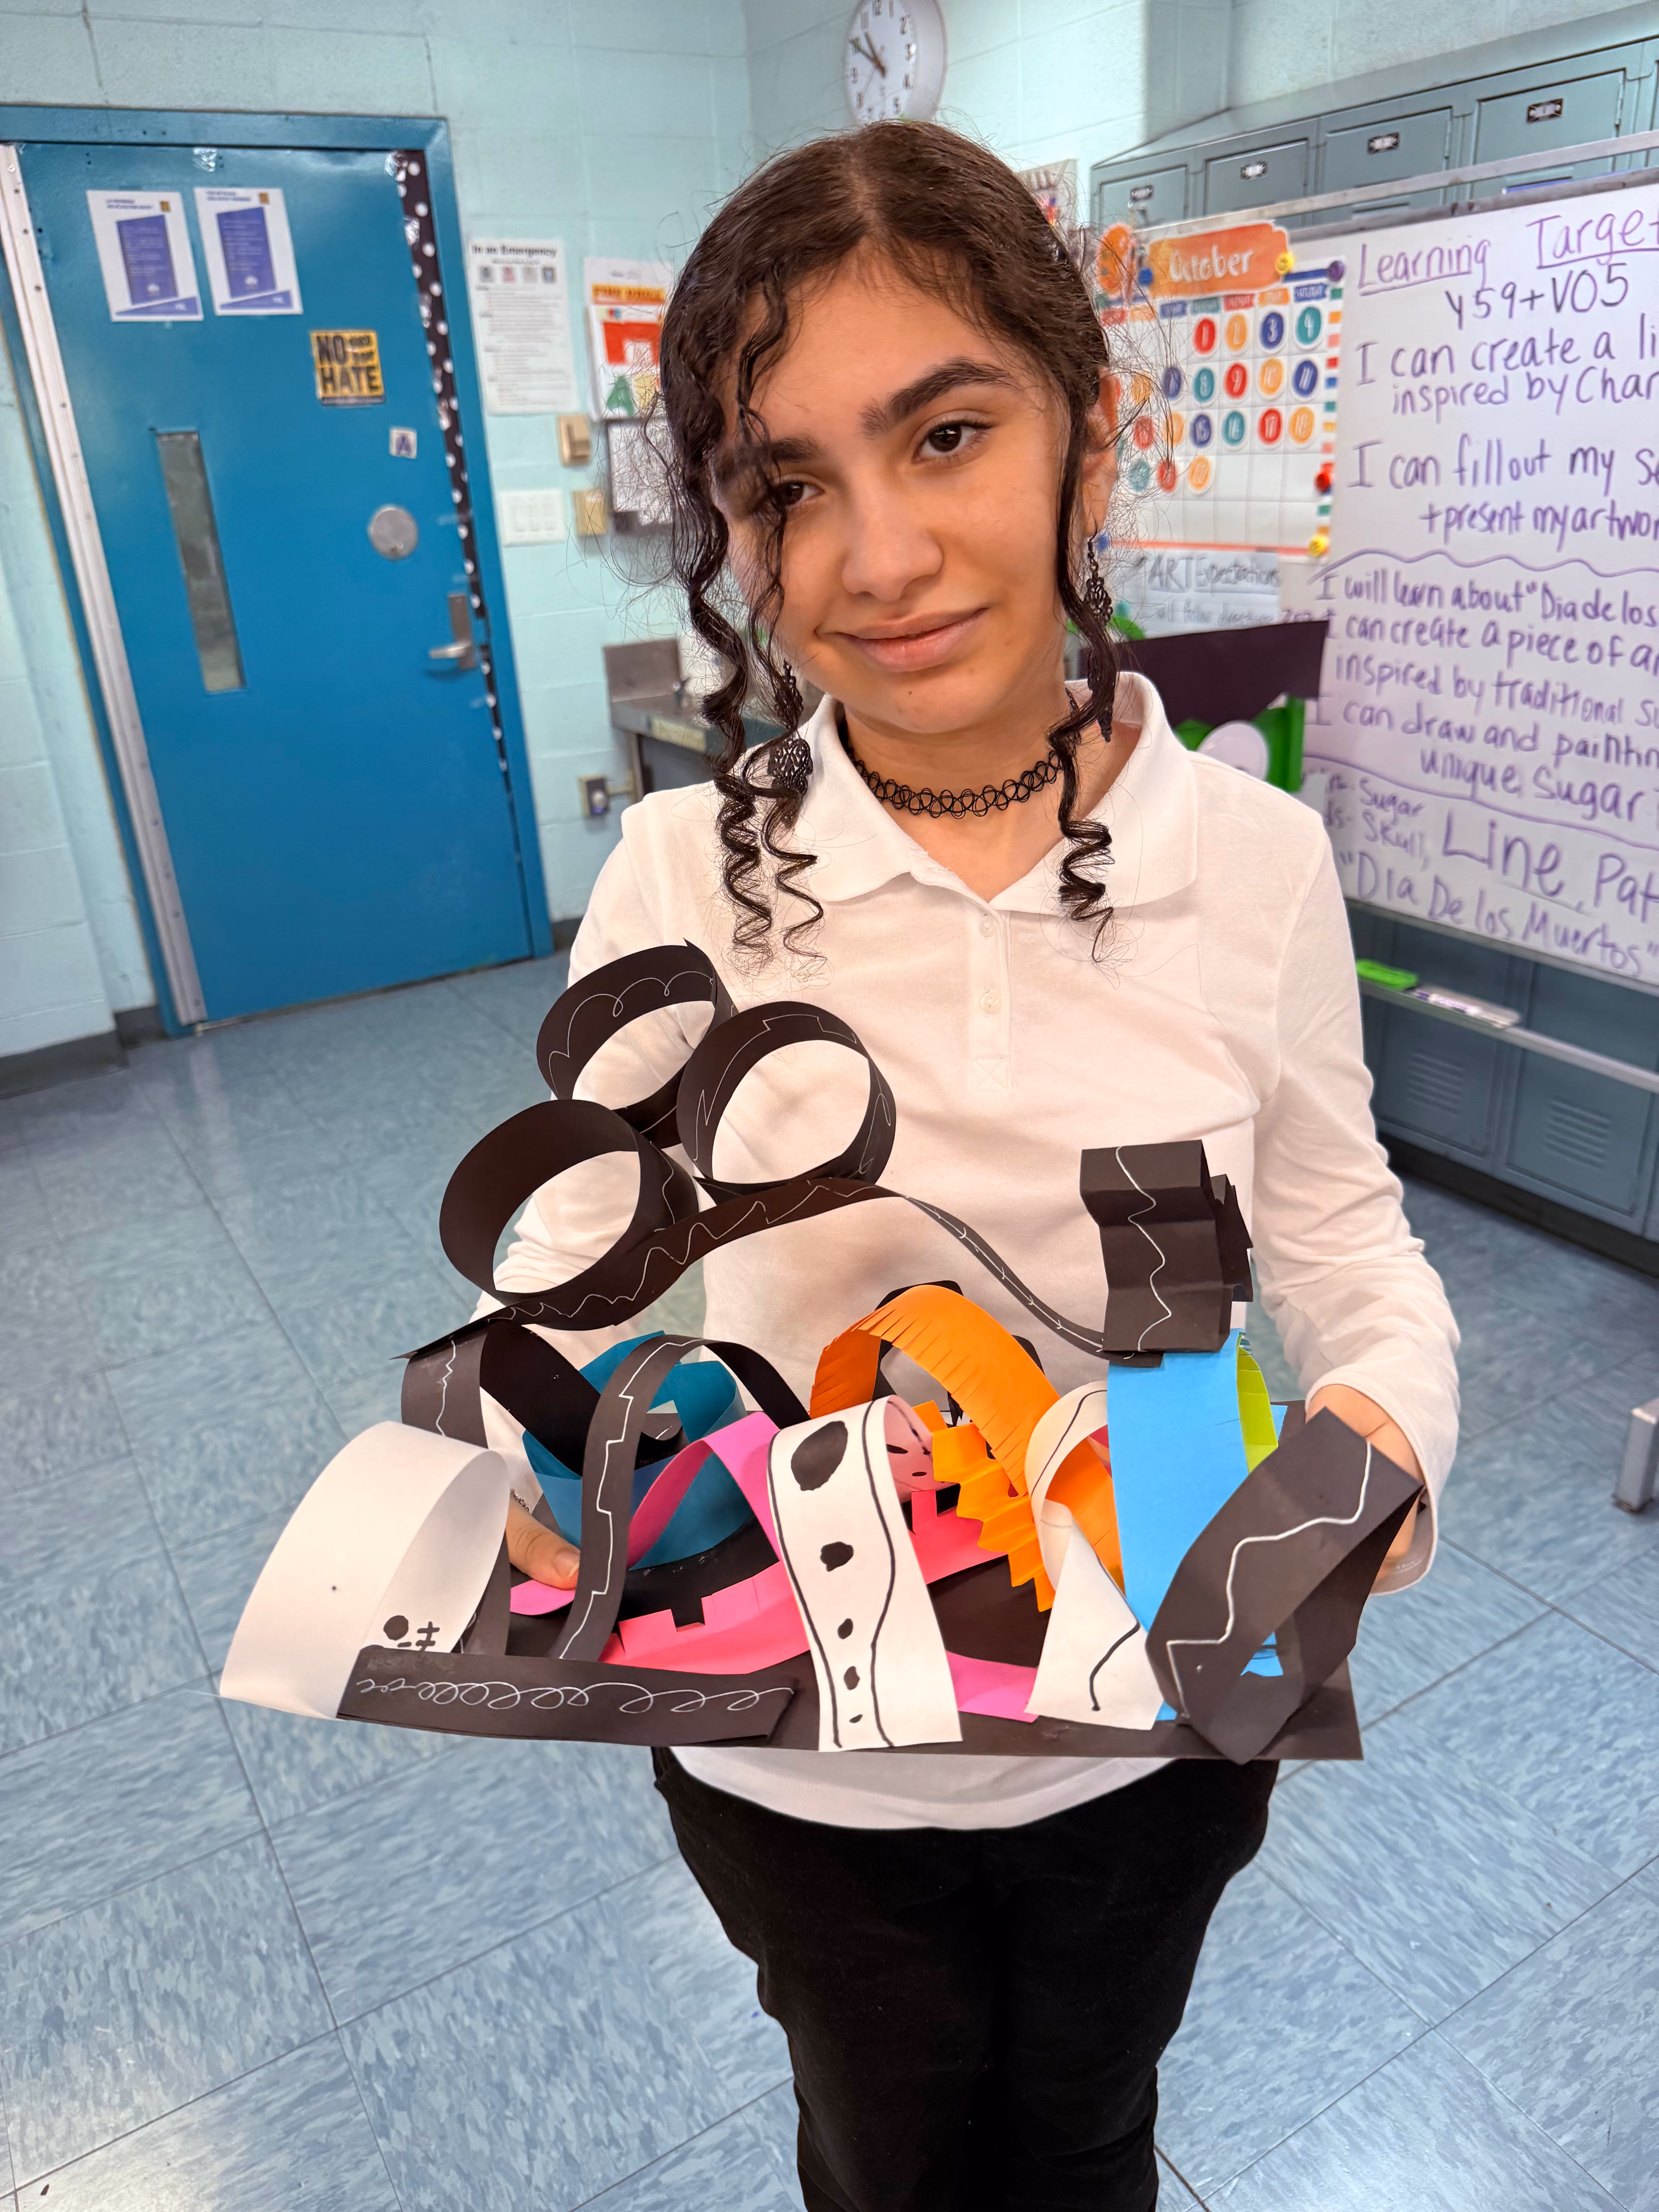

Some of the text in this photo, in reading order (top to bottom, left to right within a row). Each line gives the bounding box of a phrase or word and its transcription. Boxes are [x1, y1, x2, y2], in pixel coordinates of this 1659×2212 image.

[1169, 244, 1255, 283] October
[1358, 239, 1491, 290] Learning
[316, 335, 346, 366] NO
[1267, 319, 1277, 343] 3
[1304, 313, 1314, 339] 4
[321, 366, 380, 394] HATE
[1355, 341, 1379, 386] I
[1390, 344, 1455, 378] can
[1471, 327, 1582, 372] create
[1593, 331, 1616, 360] a
[1392, 374, 1509, 425] inspired
[1346, 440, 1384, 488] I
[1389, 454, 1441, 489] can
[1569, 446, 1615, 497] my
[1147, 555, 1194, 591] ART
[1315, 572, 1339, 601] I
[1344, 568, 1388, 605] will
[1480, 620, 1502, 648] a
[1507, 623, 1581, 670] piece
[1587, 634, 1625, 667] of
[1336, 652, 1444, 696] inspired
[1453, 663, 1486, 717] by
[1343, 699, 1394, 731] can
[1401, 700, 1476, 744] draw
[1483, 721, 1540, 752] and
[1359, 778, 1425, 826] Sugar
[1420, 747, 1523, 799] unique
[1532, 764, 1647, 821] Sugar
[1442, 809, 1566, 897] Line
[1427, 873, 1464, 925] De
